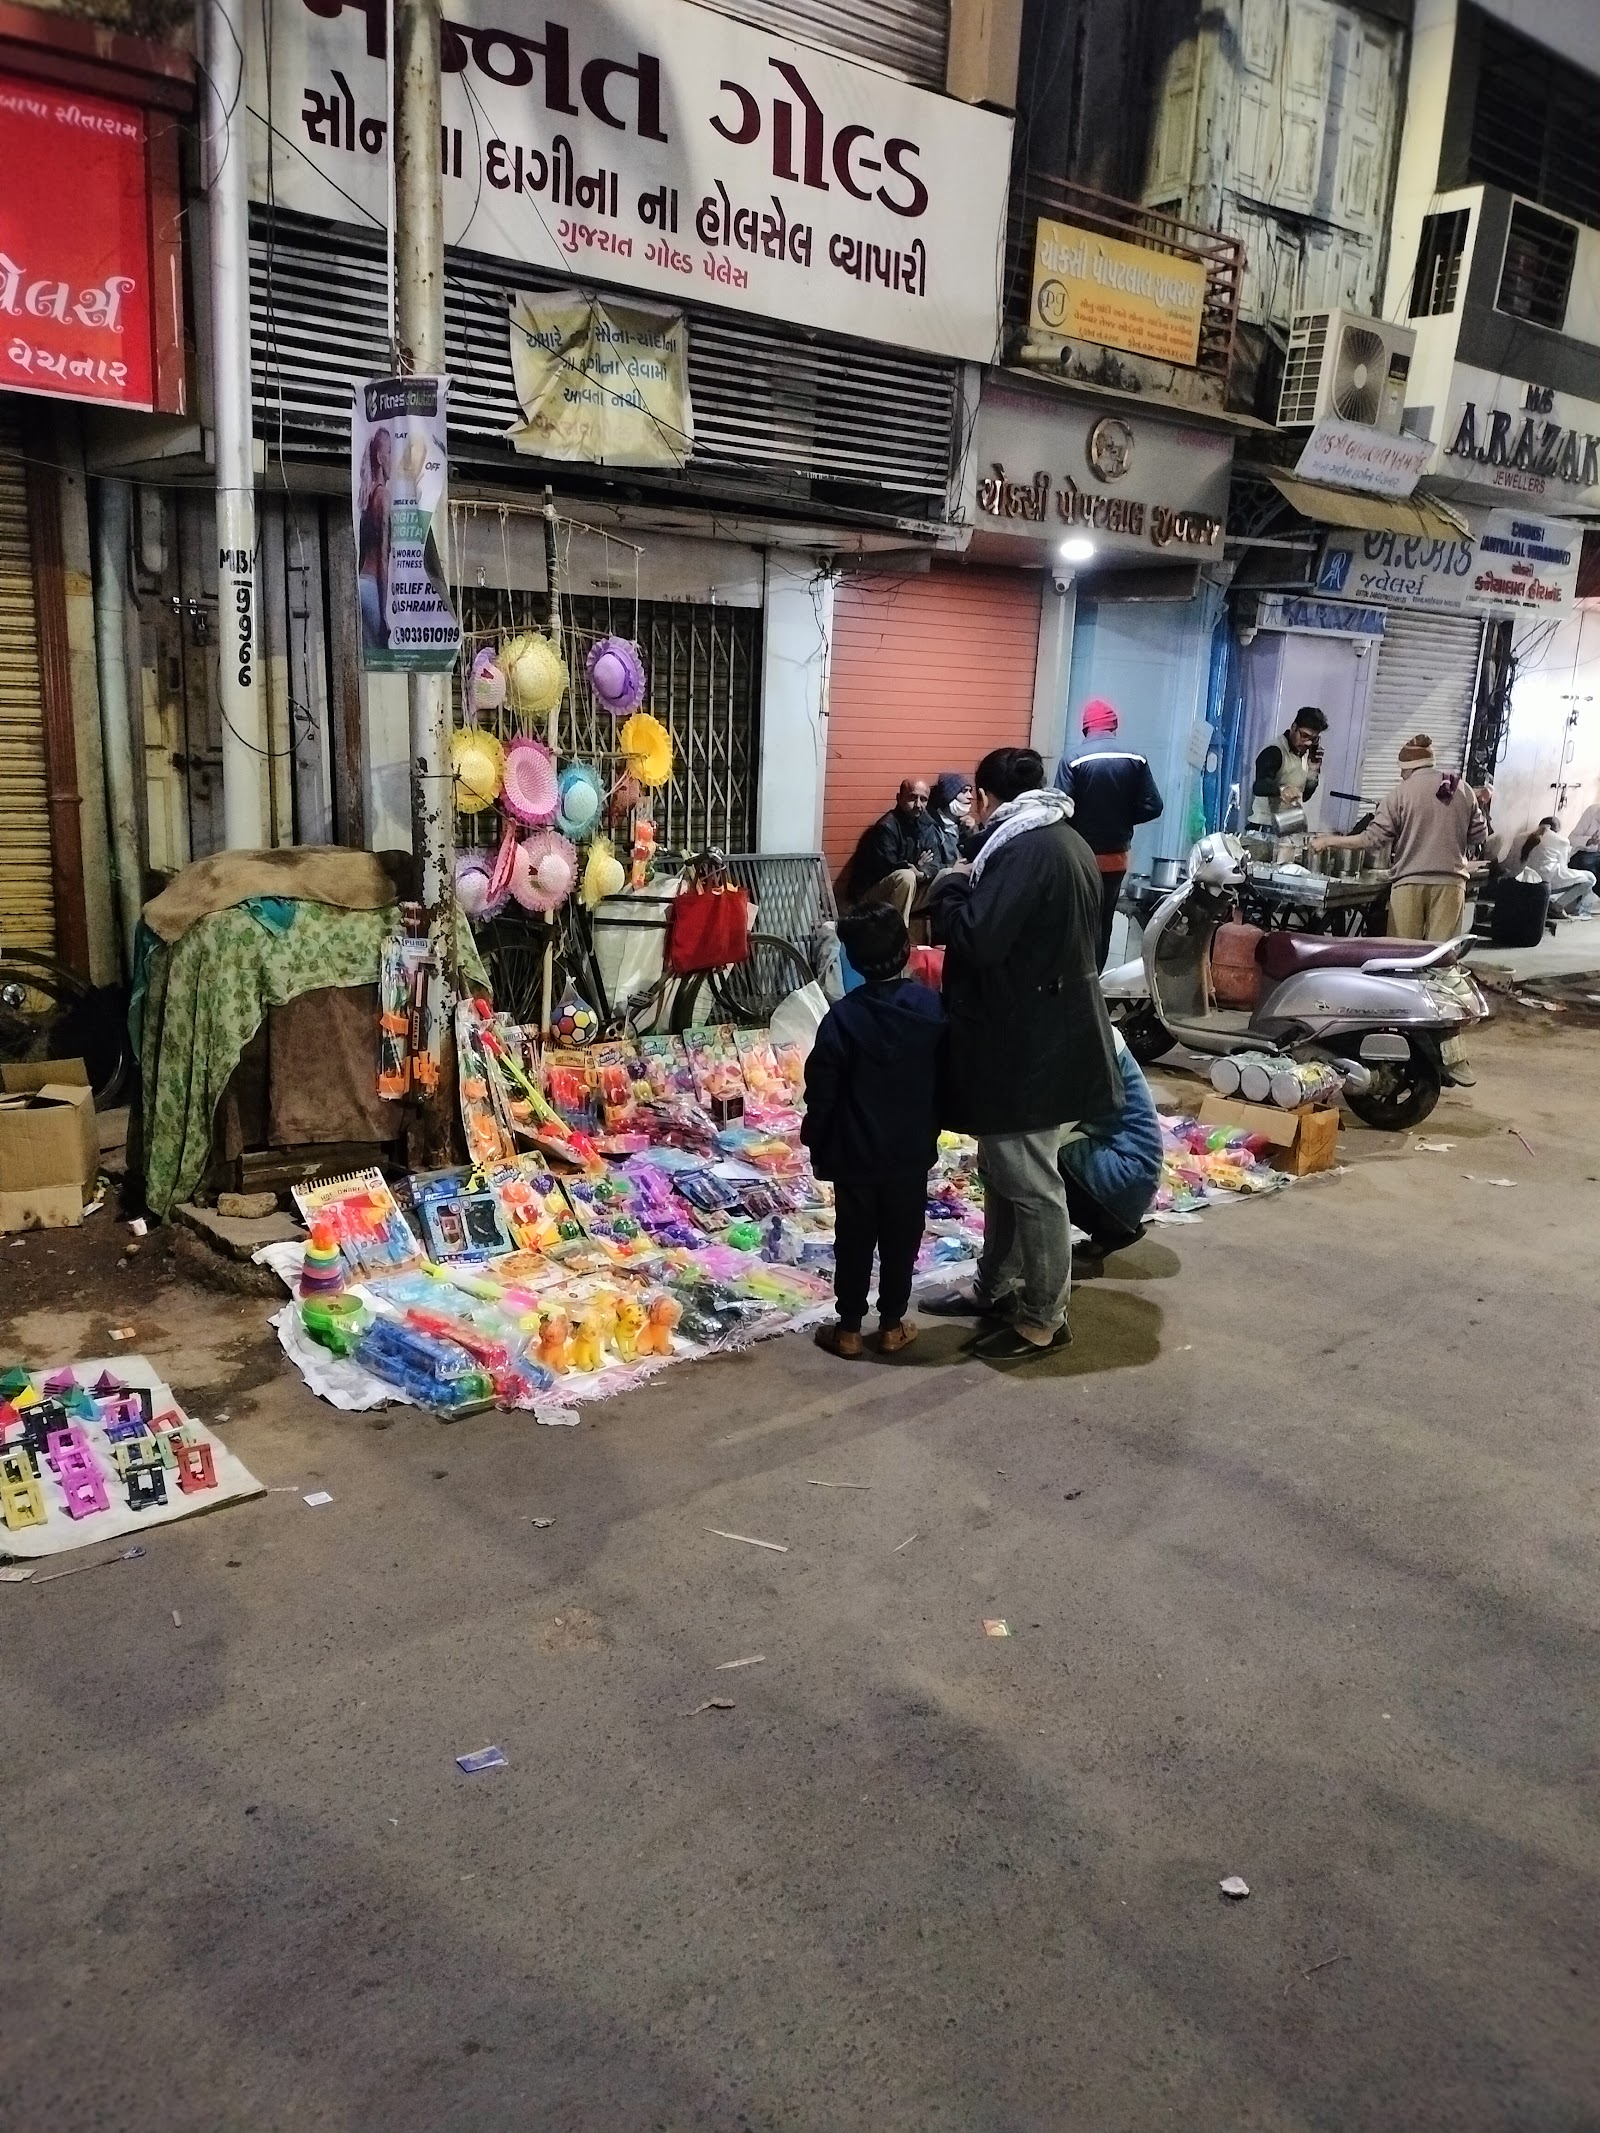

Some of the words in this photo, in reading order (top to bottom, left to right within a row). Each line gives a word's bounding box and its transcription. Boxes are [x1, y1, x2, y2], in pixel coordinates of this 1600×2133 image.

[709, 57, 928, 217] ગોલ્ડ
[487, 134, 617, 217] દાગીના
[638, 185, 678, 234] ના
[696, 178, 812, 267] હોલસેલ
[829, 233, 926, 297] વ્યાપારી
[557, 219, 633, 258] ગુજરાત
[644, 237, 693, 274] ગોલ્ડ
[703, 250, 748, 289] પેલેસ
[8, 337, 127, 386] વેચનાર
[627, 356, 668, 381] લેવામાં
[563, 388, 604, 406] આવતા
[425, 461, 441, 472] OFF
[1493, 471, 1546, 494] JEWELLERS
[397, 560, 422, 569] FITNESS
[396, 582, 424, 595] RELIEF
